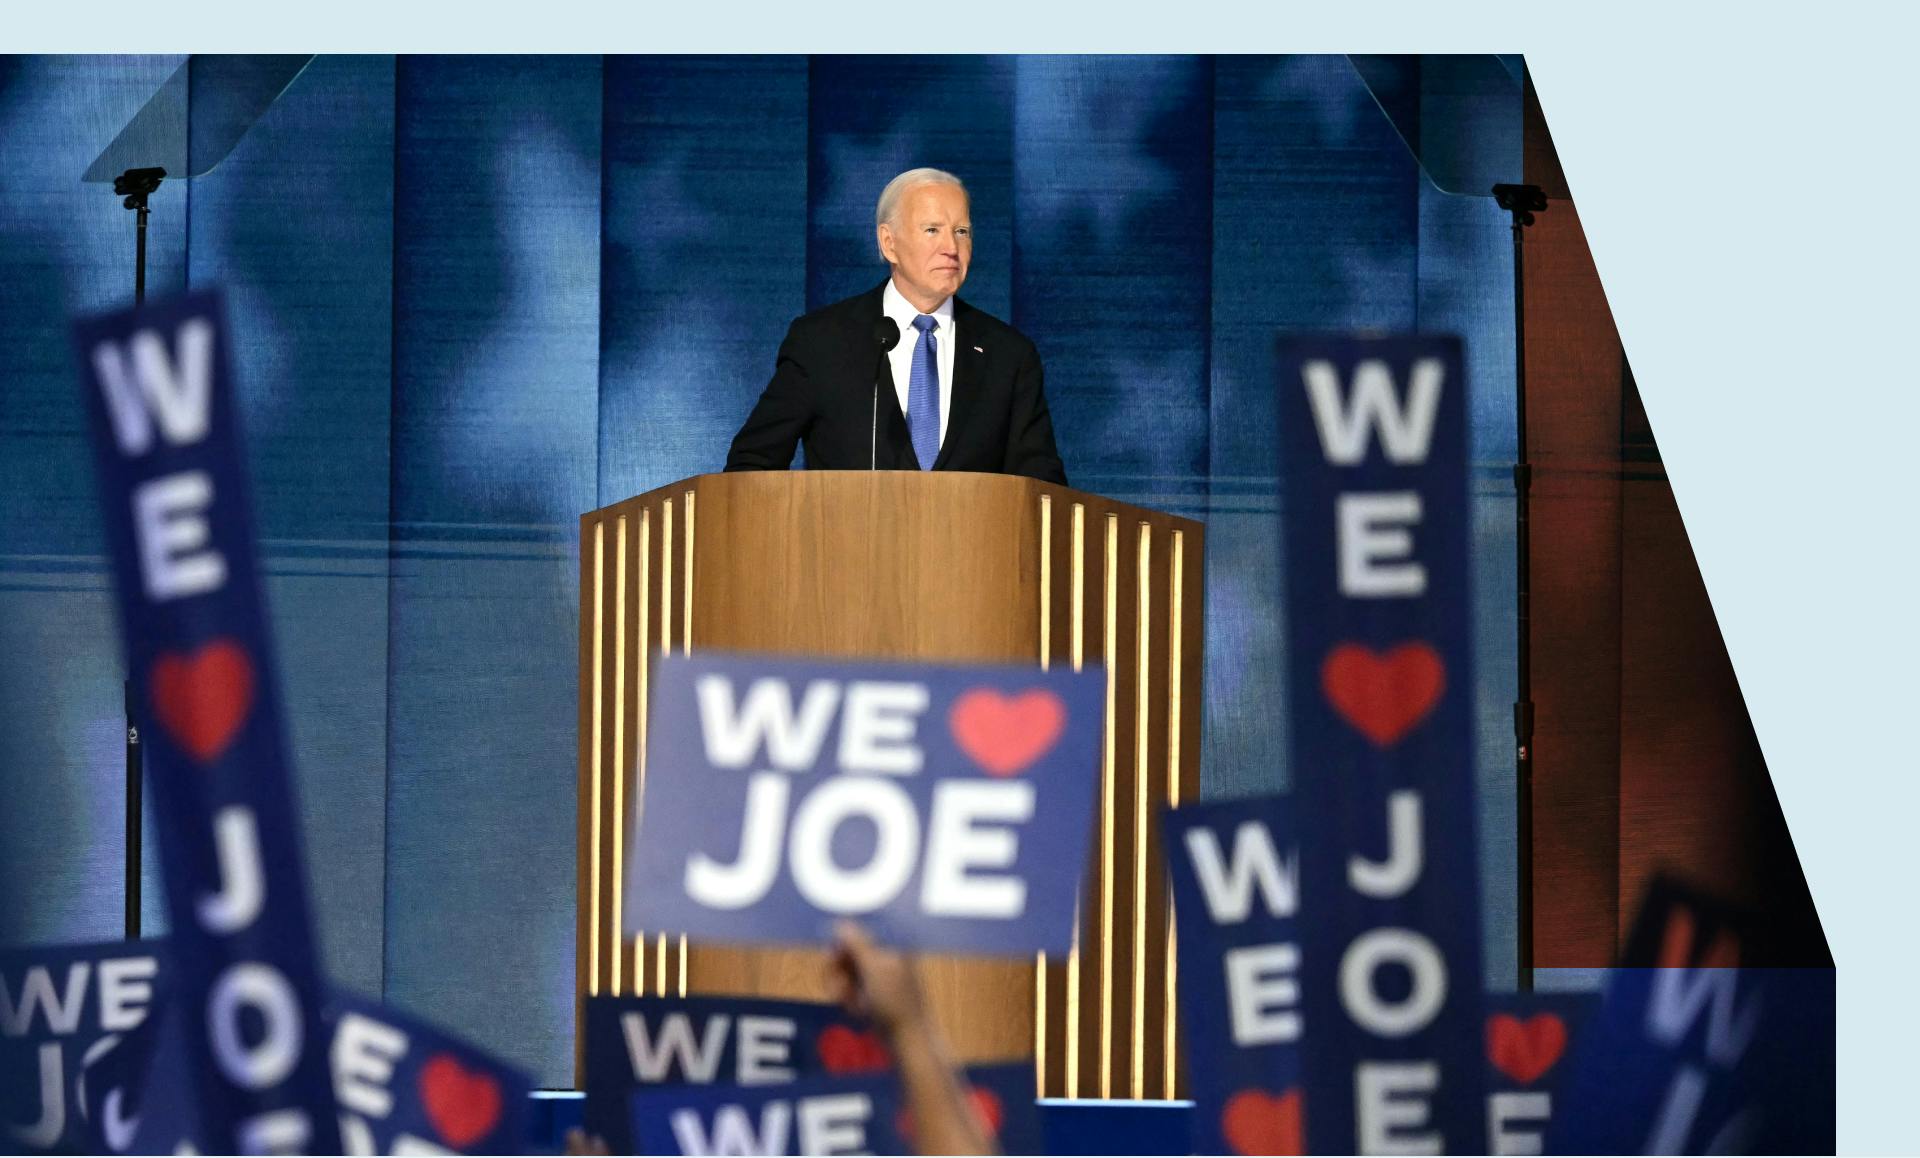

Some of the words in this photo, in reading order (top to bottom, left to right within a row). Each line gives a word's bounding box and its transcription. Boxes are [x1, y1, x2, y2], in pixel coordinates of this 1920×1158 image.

[1302, 357, 1446, 597] WE
[695, 676, 930, 778] WE
[684, 774, 1036, 920] JOE
[0, 957, 158, 1037] WE
[1337, 788, 1448, 1155] JOE
[620, 1010, 798, 1087] WE
[670, 1092, 872, 1155] WE
